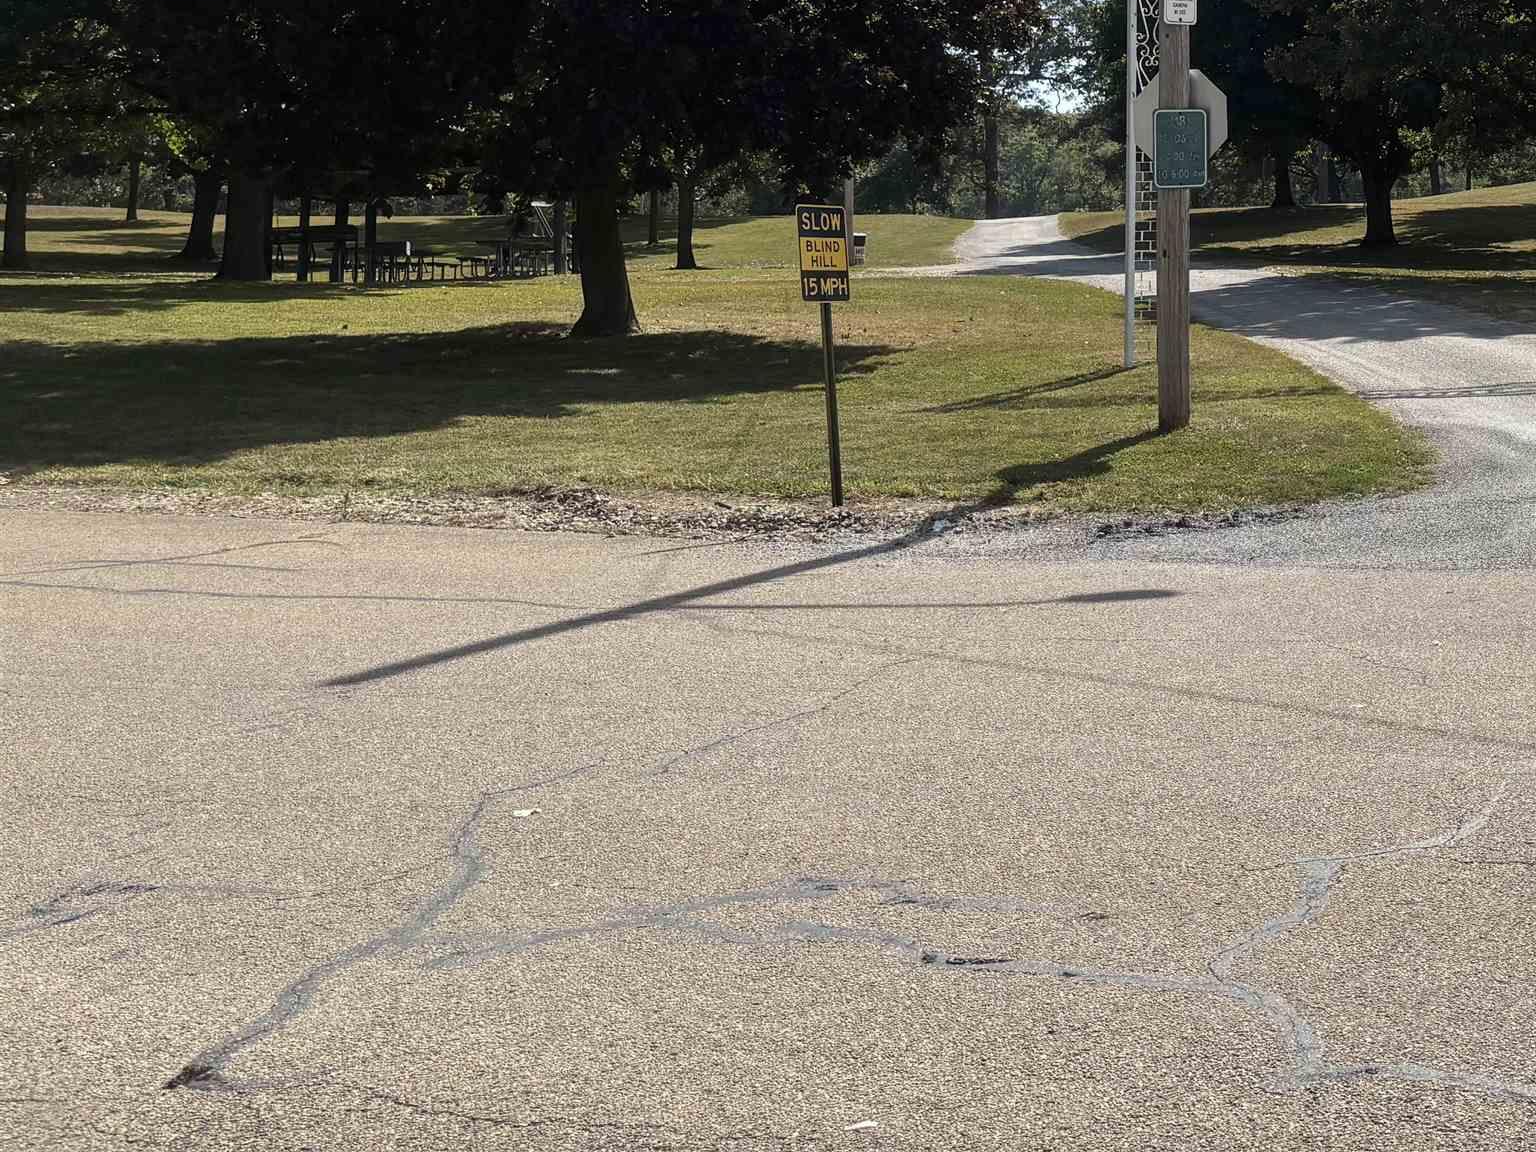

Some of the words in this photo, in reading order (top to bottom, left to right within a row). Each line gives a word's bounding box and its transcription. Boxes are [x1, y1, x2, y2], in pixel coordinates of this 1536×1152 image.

[802, 213, 840, 230] SLOW
[806, 240, 840, 252] BLIND
[811, 256, 837, 267] HILL
[803, 277, 818, 297] 15
[820, 277, 848, 296] MPH
